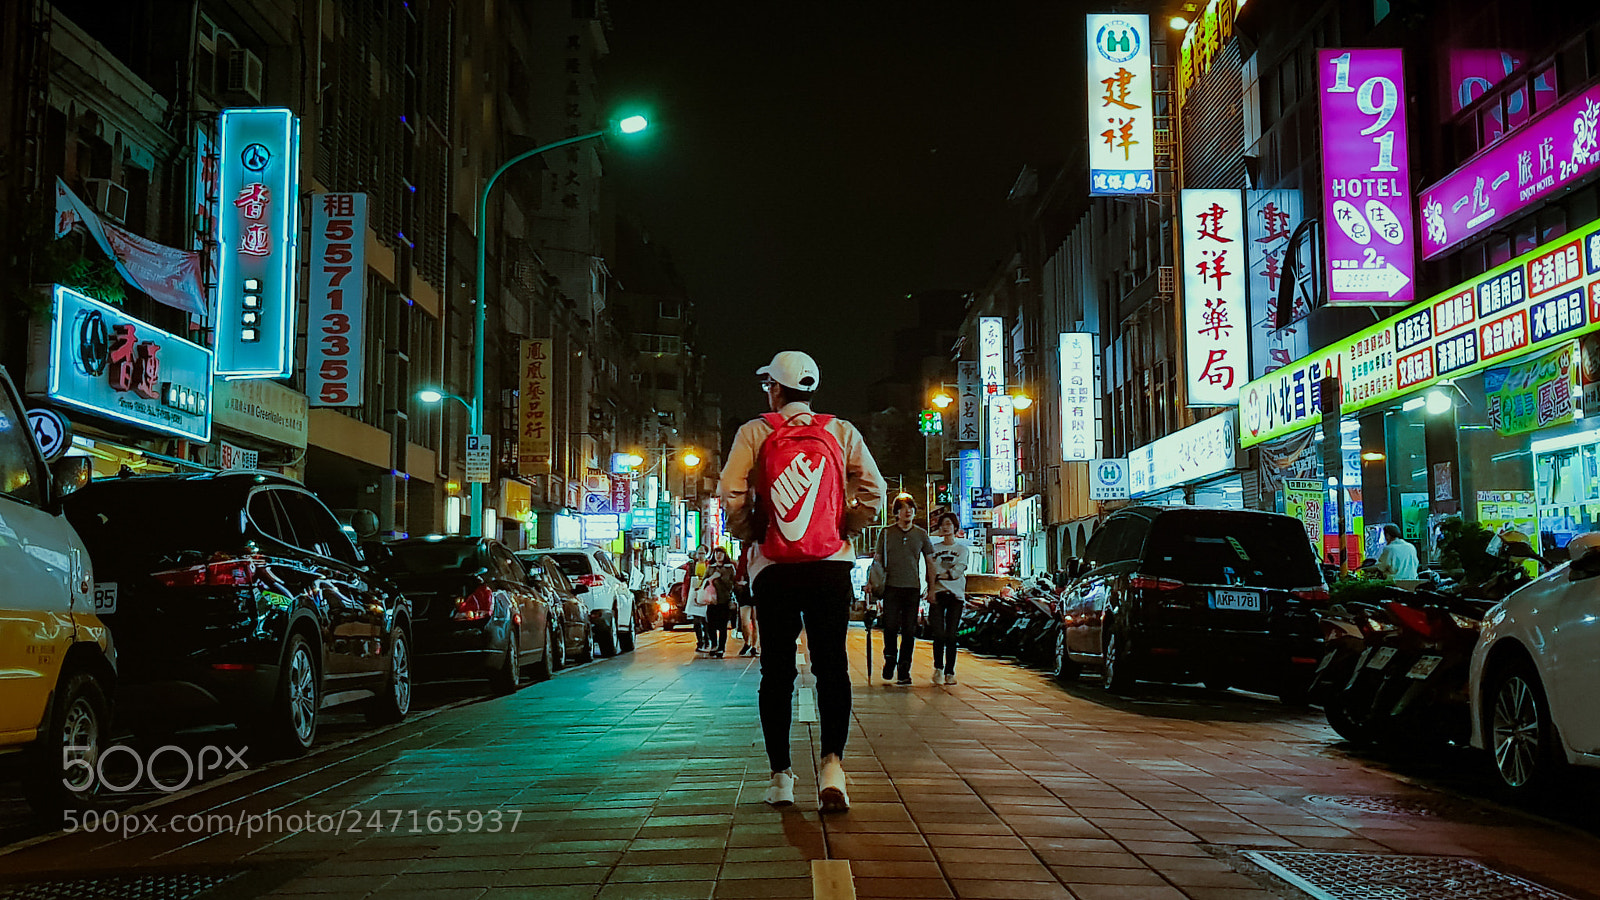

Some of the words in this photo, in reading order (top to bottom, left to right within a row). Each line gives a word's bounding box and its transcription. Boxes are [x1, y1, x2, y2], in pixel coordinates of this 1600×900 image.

[1101, 67, 1142, 161] 建祥
[1327, 53, 1399, 172] 191
[1333, 178, 1402, 197] HOTEL
[1537, 175, 1555, 192] HOTEL
[1363, 248, 1385, 268] 2F
[1531, 245, 1580, 294] 生活用品
[1196, 202, 1235, 391] 建祥藥局
[1399, 349, 1432, 387] 文具玩具
[1534, 292, 1582, 338] 水電用品
[1266, 362, 1321, 430] 小北百貨
[1537, 378, 1571, 427] 優惠
[470, 439, 477, 448] P
[770, 452, 817, 518] NIKE
[972, 488, 982, 500] P
[1216, 594, 1258, 607] AKP-1781
